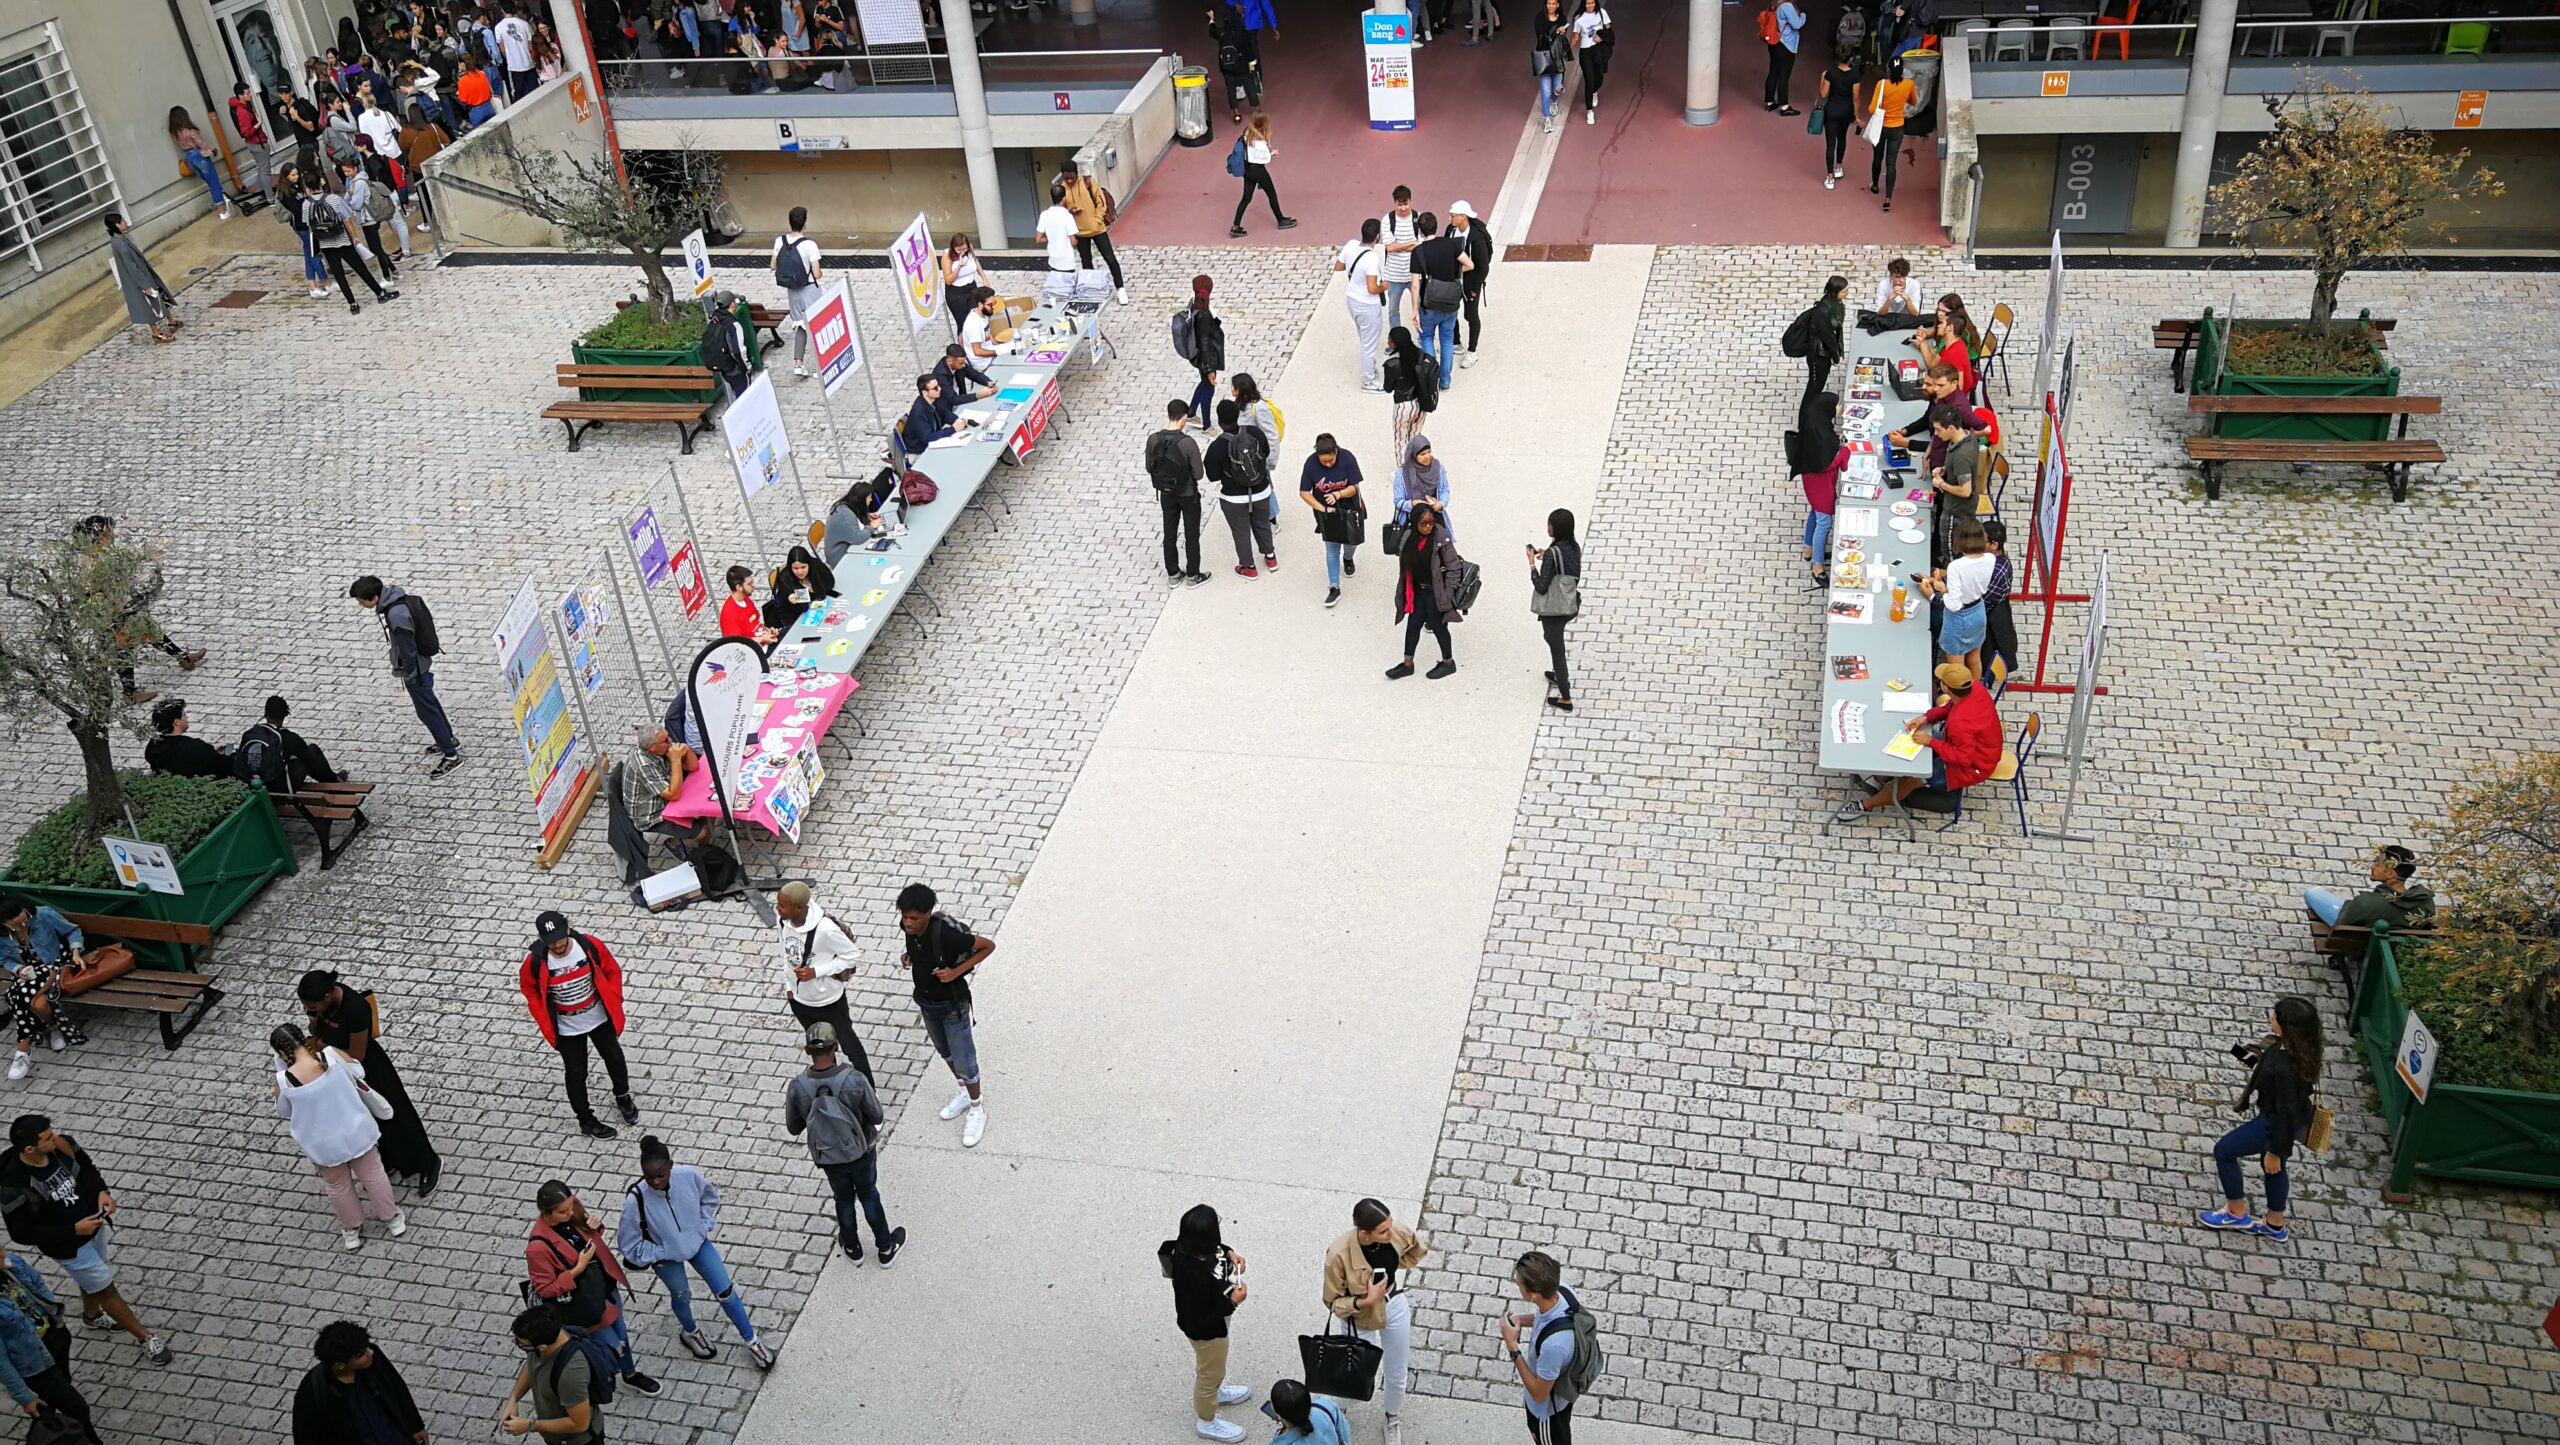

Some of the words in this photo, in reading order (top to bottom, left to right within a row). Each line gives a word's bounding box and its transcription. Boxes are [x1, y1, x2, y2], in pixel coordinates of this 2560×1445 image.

[1371, 31, 1394, 41] sang
[1374, 22, 1393, 31] Don
[1371, 63, 1385, 82] 24
[577, 100, 590, 122] A4
[779, 123, 792, 138] B
[2063, 144, 2095, 219] B-003
[815, 312, 845, 355] uni
[722, 741, 734, 778] SECOURS
[729, 692, 744, 739] POPULAIRE
